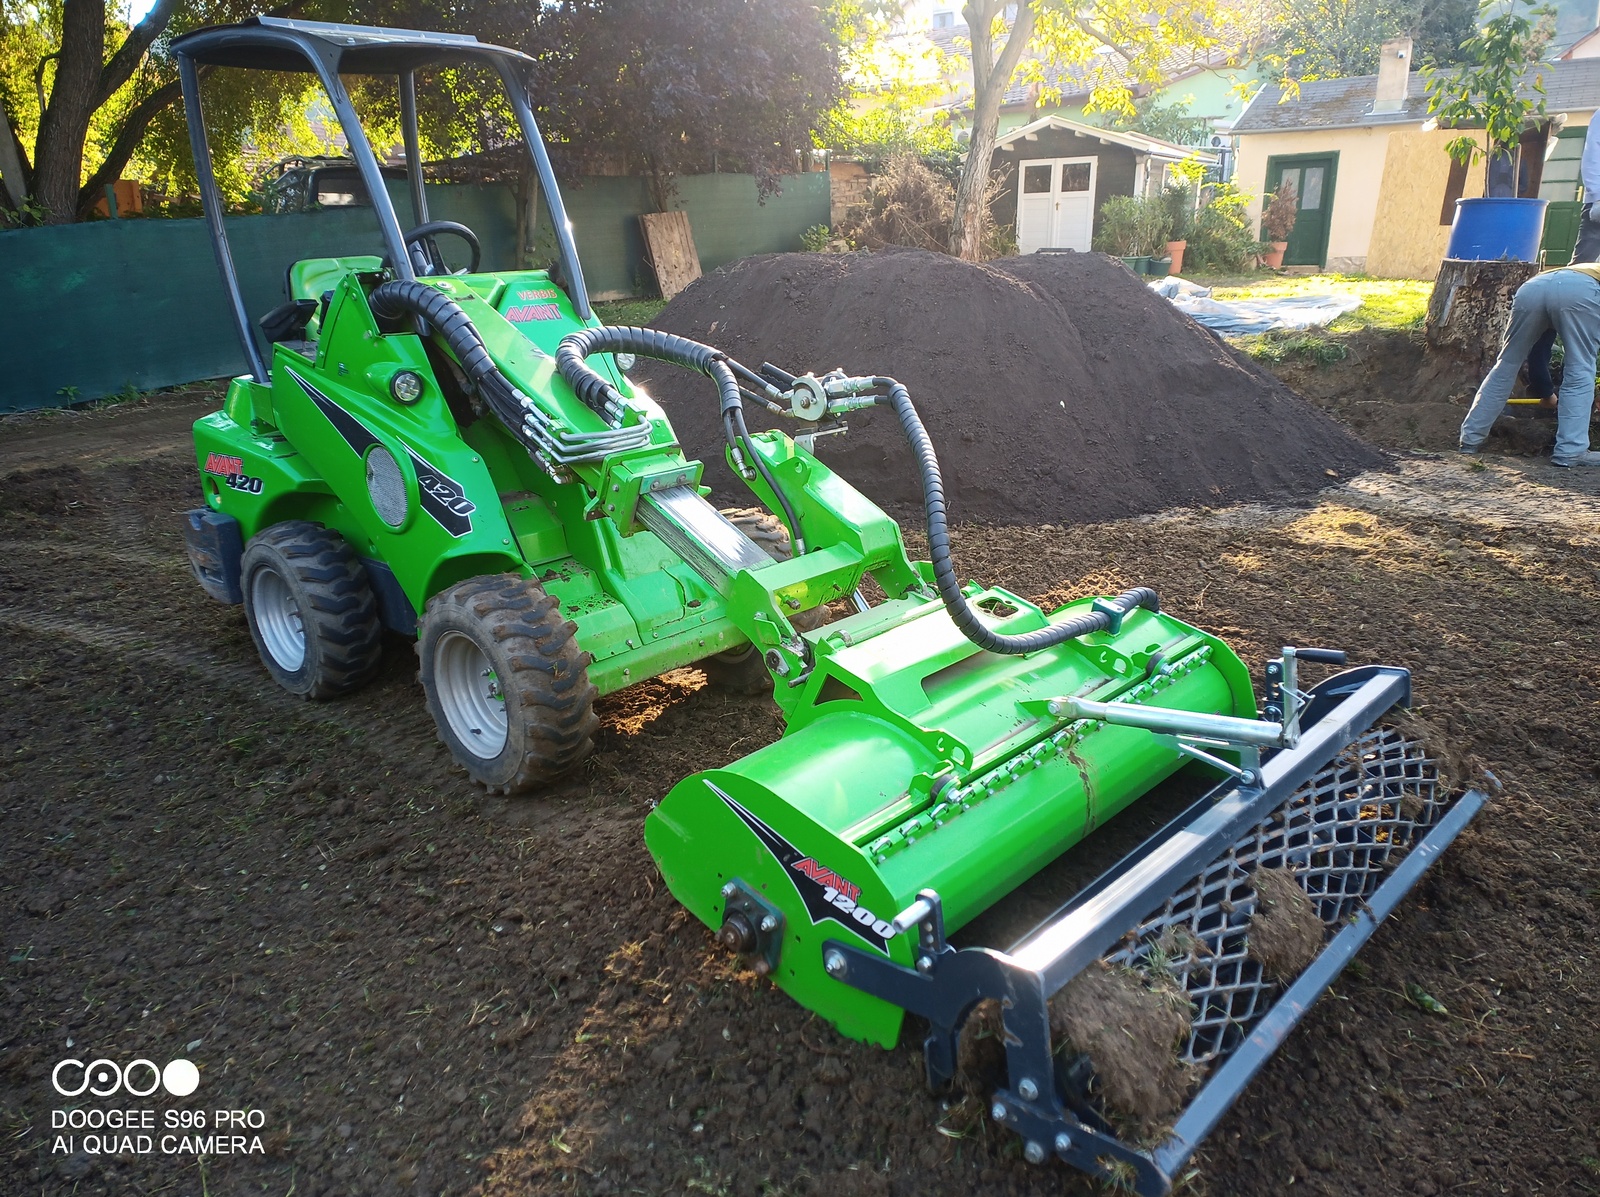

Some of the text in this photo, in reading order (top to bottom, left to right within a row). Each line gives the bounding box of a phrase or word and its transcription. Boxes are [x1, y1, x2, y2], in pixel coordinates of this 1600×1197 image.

[517, 289, 557, 300] VERBIS
[505, 303, 561, 323] AVANT
[204, 452, 243, 476] AVANT
[226, 473, 263, 495] 420
[418, 475, 476, 516] 420
[791, 858, 861, 904] AVANT
[823, 887, 897, 939] 1200
